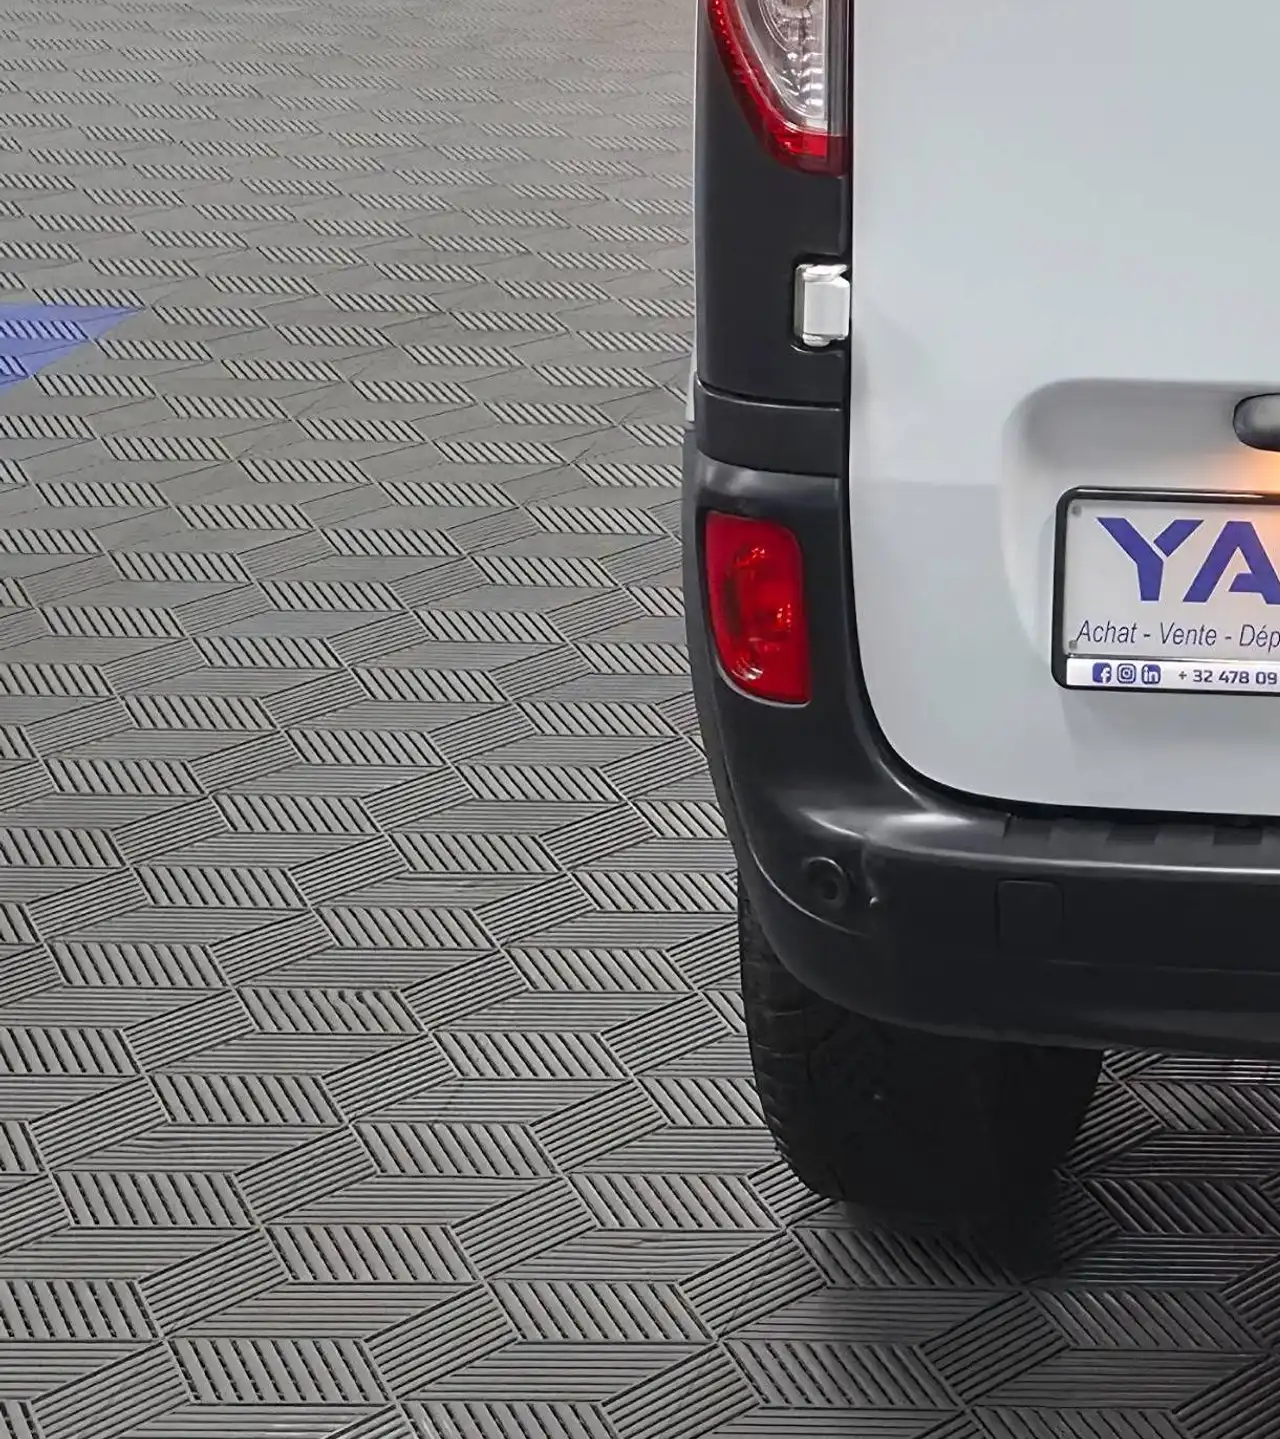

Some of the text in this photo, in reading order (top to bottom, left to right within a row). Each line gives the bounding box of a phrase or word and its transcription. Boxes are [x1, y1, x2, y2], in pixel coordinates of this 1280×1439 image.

[1076, 619, 1138, 644] Achat
[1159, 622, 1217, 645] Vente
[1192, 670, 1213, 683] 32
[1218, 671, 1250, 684] 478
[1255, 671, 1278, 685] 09
